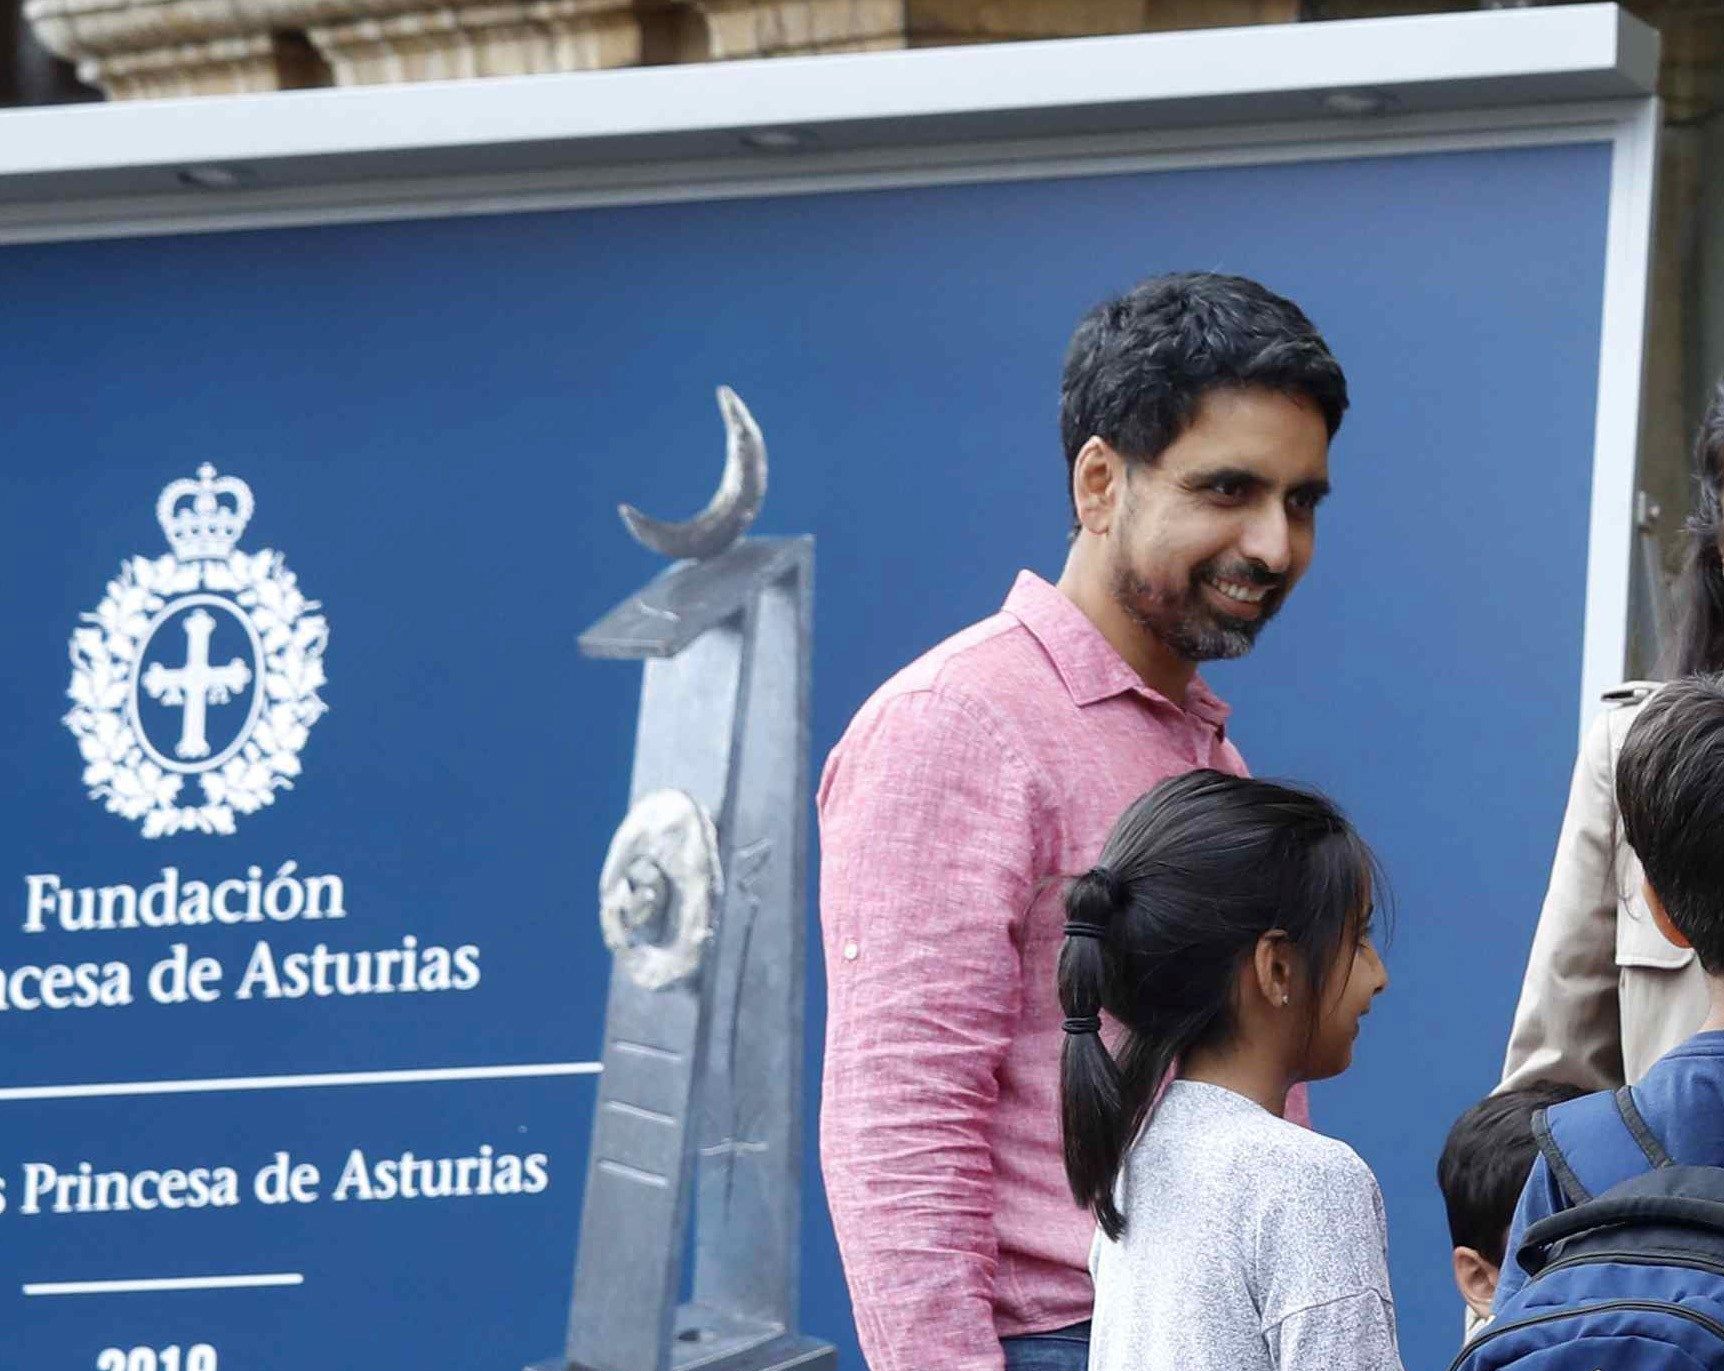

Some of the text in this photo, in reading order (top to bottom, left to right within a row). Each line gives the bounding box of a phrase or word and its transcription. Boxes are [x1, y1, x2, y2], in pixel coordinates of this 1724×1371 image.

[22, 859, 346, 933] Fundación
[0, 934, 481, 1011] cesa de Asturias
[20, 1161, 240, 1215] Princesa
[253, 1150, 321, 1206] de
[332, 1144, 549, 1202] Asturias
